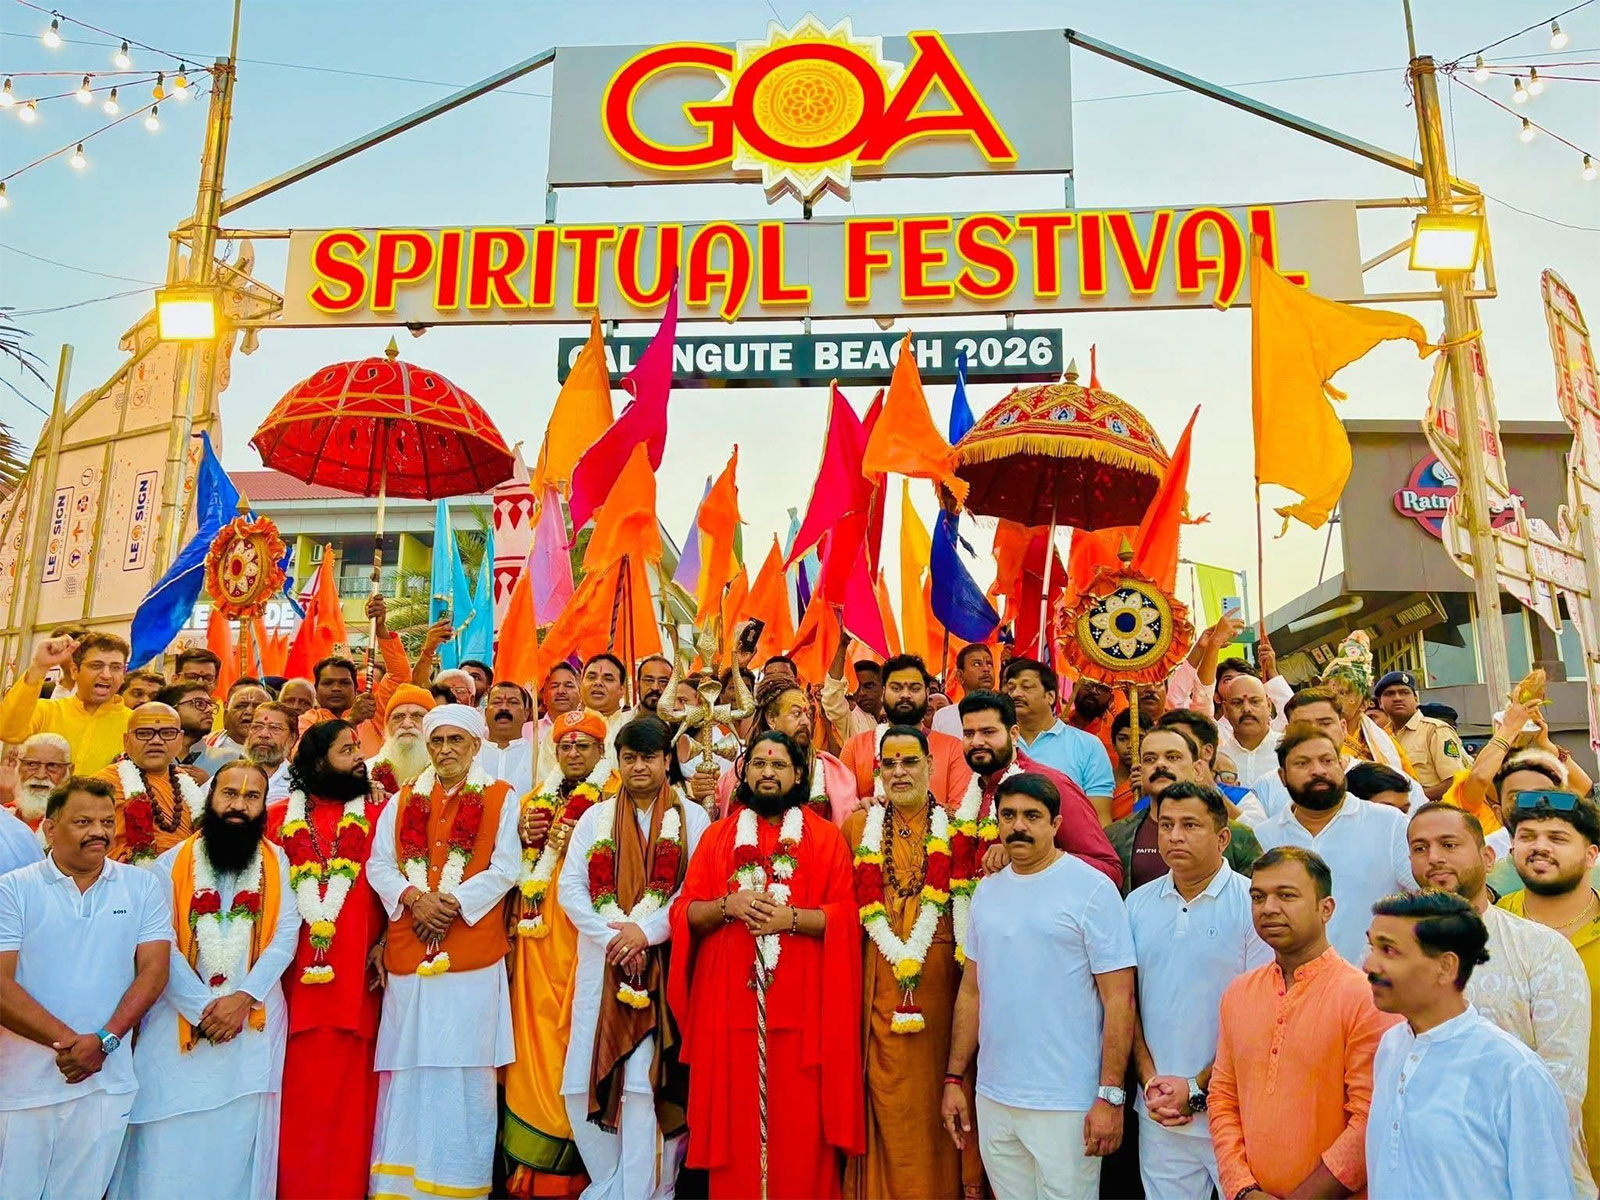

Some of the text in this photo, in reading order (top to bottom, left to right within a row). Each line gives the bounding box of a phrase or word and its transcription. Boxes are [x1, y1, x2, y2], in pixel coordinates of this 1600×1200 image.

[602, 30, 1018, 170] GOA
[307, 206, 1309, 322] SPIRITUAL FESTIVAL
[815, 339, 942, 370] BEACH
[955, 337, 1053, 368] 2026
[54, 495, 66, 535] SIGN
[135, 480, 149, 521] SIGN
